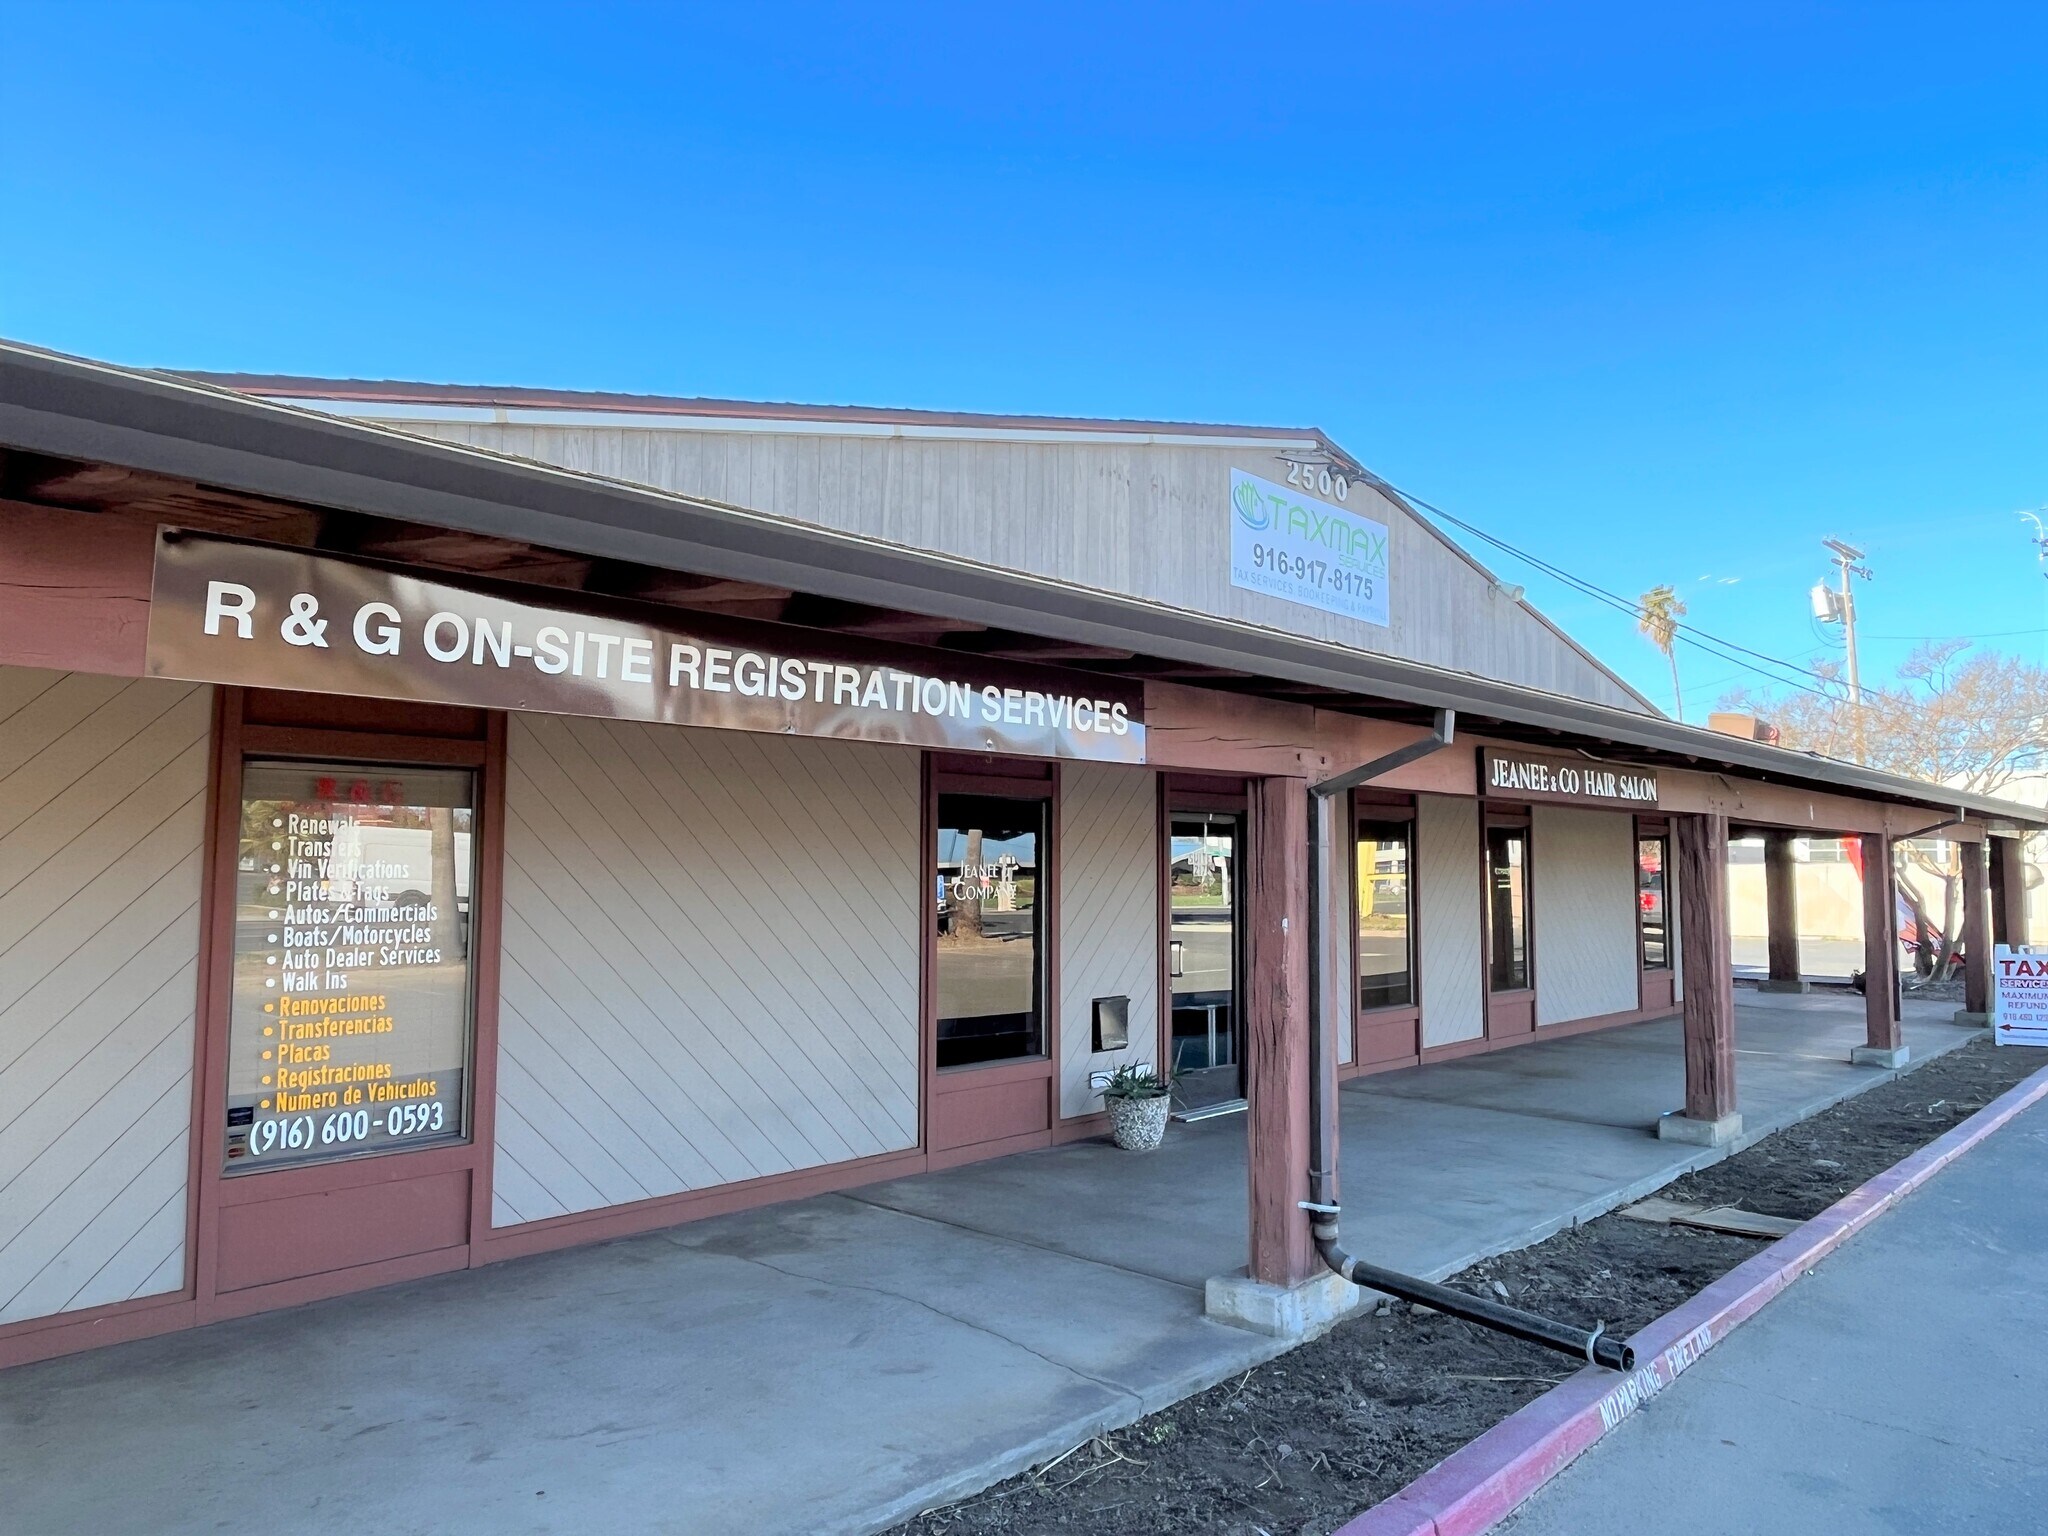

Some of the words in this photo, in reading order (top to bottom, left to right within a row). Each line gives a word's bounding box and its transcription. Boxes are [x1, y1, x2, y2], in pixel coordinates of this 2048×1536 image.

[1286, 461, 1348, 501] 2500
[1267, 494, 1386, 567] TAXMAX
[1233, 566, 1249, 581] TAX
[1253, 543, 1373, 601] 916-917-8175
[204, 580, 256, 639] R
[280, 593, 329, 648] &
[353, 602, 402, 656] G
[423, 611, 653, 684] ON-SITE
[669, 643, 971, 719] REGISTRATION
[980, 685, 1129, 736] SERVICES
[1491, 758, 1549, 792] JEANEE
[1550, 775, 1557, 792] &
[1559, 767, 1580, 794] CO
[1584, 769, 1617, 798] HAIR
[1620, 774, 1658, 802] SALON
[288, 813, 361, 835] Renewals
[287, 858, 312, 879] Vin
[318, 858, 410, 880] Verifications
[286, 880, 336, 902] Plates
[355, 880, 390, 906] Tags
[953, 881, 1017, 901] COMPANY
[282, 949, 320, 970] Auto
[325, 947, 375, 968] Dealer
[379, 946, 441, 967] Services
[1999, 960, 2048, 976] TAX
[282, 971, 318, 993] Walk
[325, 971, 348, 990] Ins
[279, 994, 386, 1017] Renovaciones
[2008, 1001, 2047, 1010] REFUND
[278, 1015, 393, 1041] Transferencias
[277, 1043, 331, 1065] Placas
[276, 1062, 392, 1092] Registraciones
[275, 1090, 337, 1114] Numero
[343, 1086, 362, 1104] de
[367, 1078, 437, 1103] Vehiculos
[249, 1115, 315, 1156] (916)
[1600, 1395, 1619, 1431] NO
[1615, 1361, 1661, 1417] PARKING
